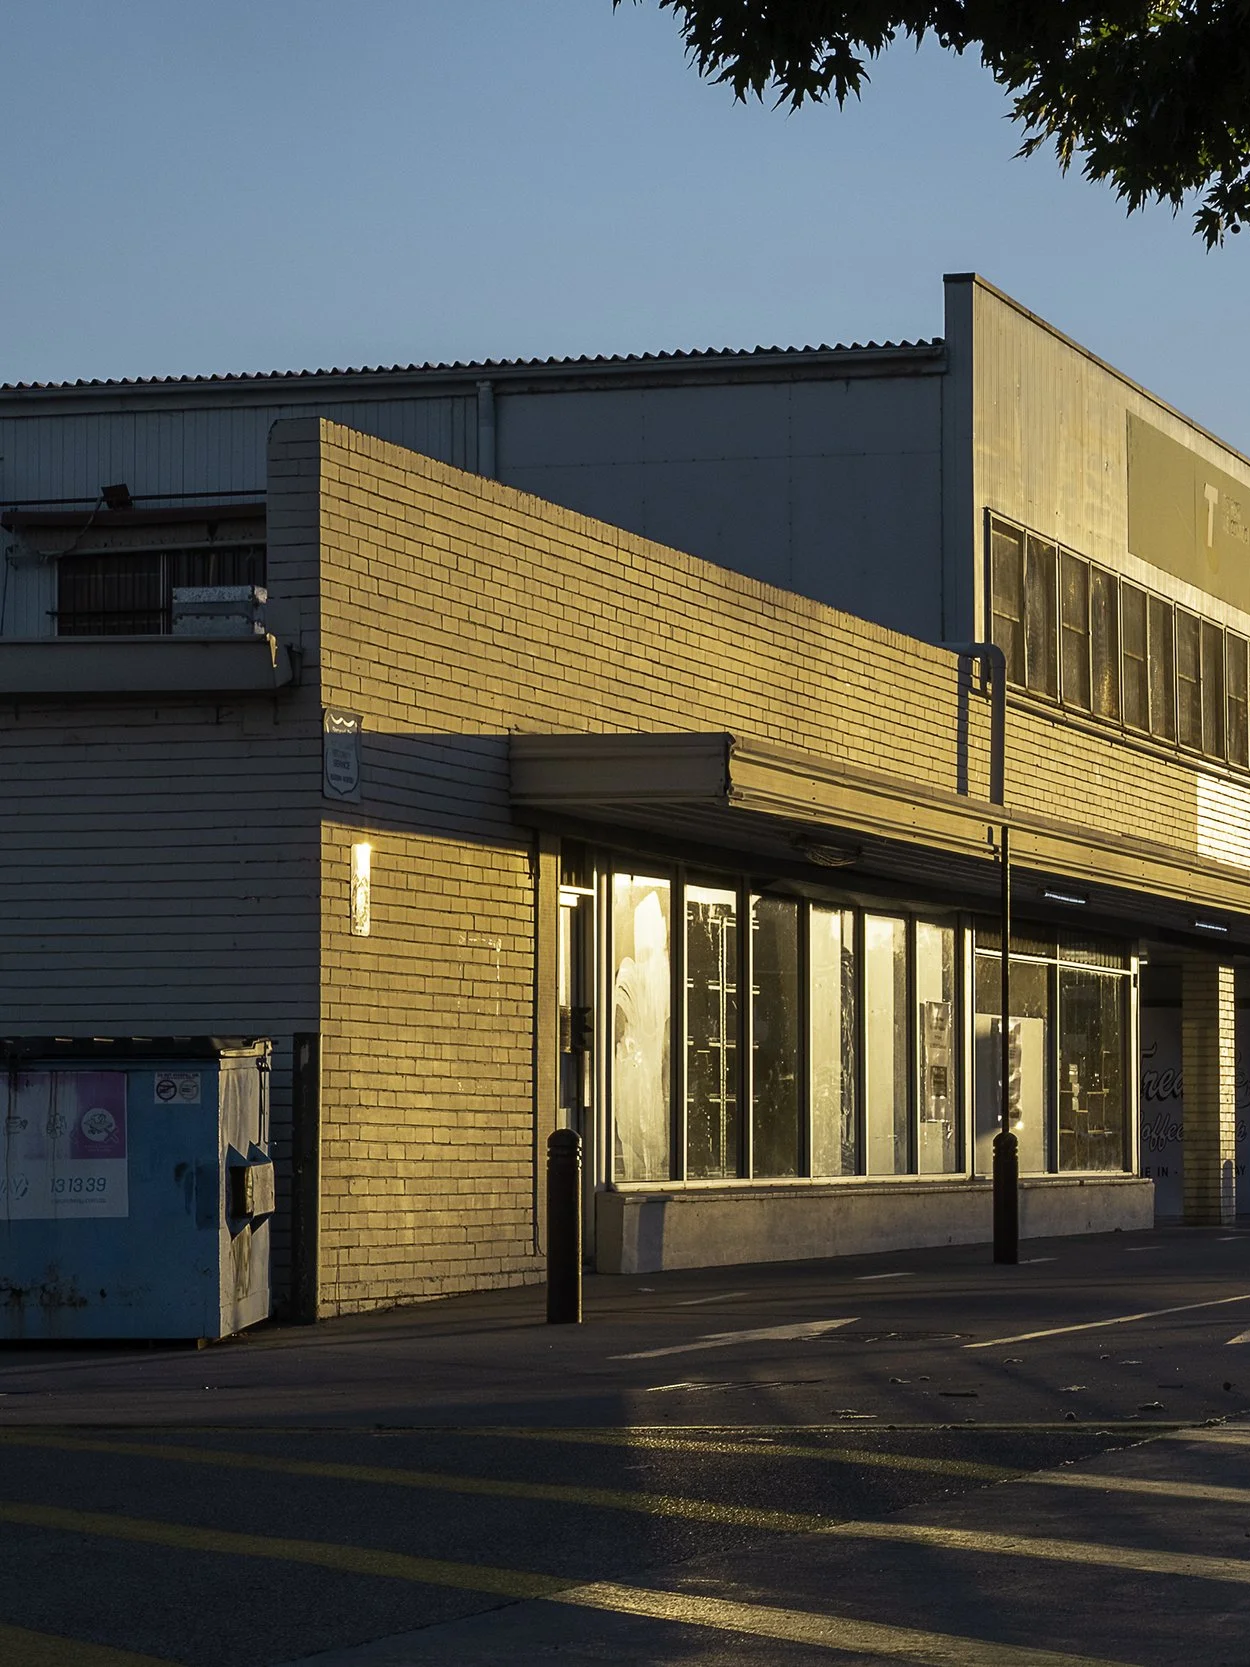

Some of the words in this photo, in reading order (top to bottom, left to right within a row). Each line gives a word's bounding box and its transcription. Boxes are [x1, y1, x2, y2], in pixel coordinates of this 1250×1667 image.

[1157, 1167, 1168, 1177] IN
[51, 1178, 66, 1193] 13
[68, 1177, 84, 1193] 13
[86, 1177, 107, 1192] 39
